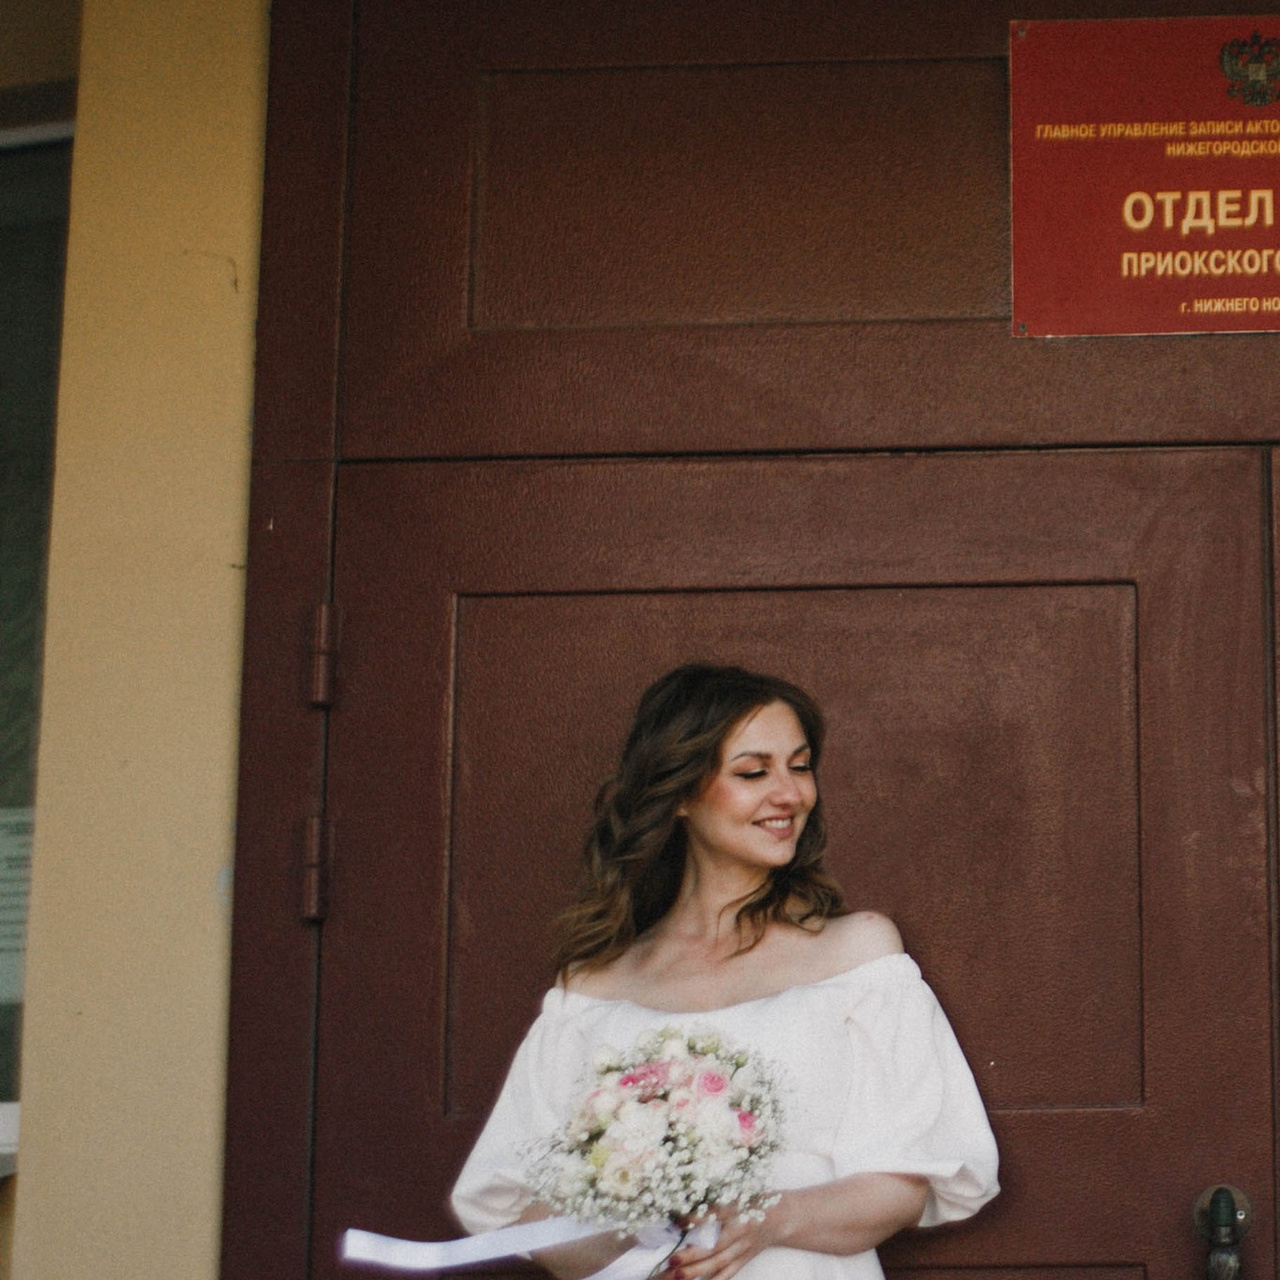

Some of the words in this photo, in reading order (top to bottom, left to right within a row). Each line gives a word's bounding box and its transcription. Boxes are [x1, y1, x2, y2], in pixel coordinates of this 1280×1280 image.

[1037, 124, 1095, 139] ГЛАВНОЕ
[1100, 122, 1186, 137] УПРАВЛЕНИЕ
[1190, 121, 1243, 135] ЗАПИСИ
[1123, 190, 1273, 235] ОТДЕЛ
[1180, 303, 1190, 313] г.
[1194, 297, 1259, 312] НИЖНЕГО
